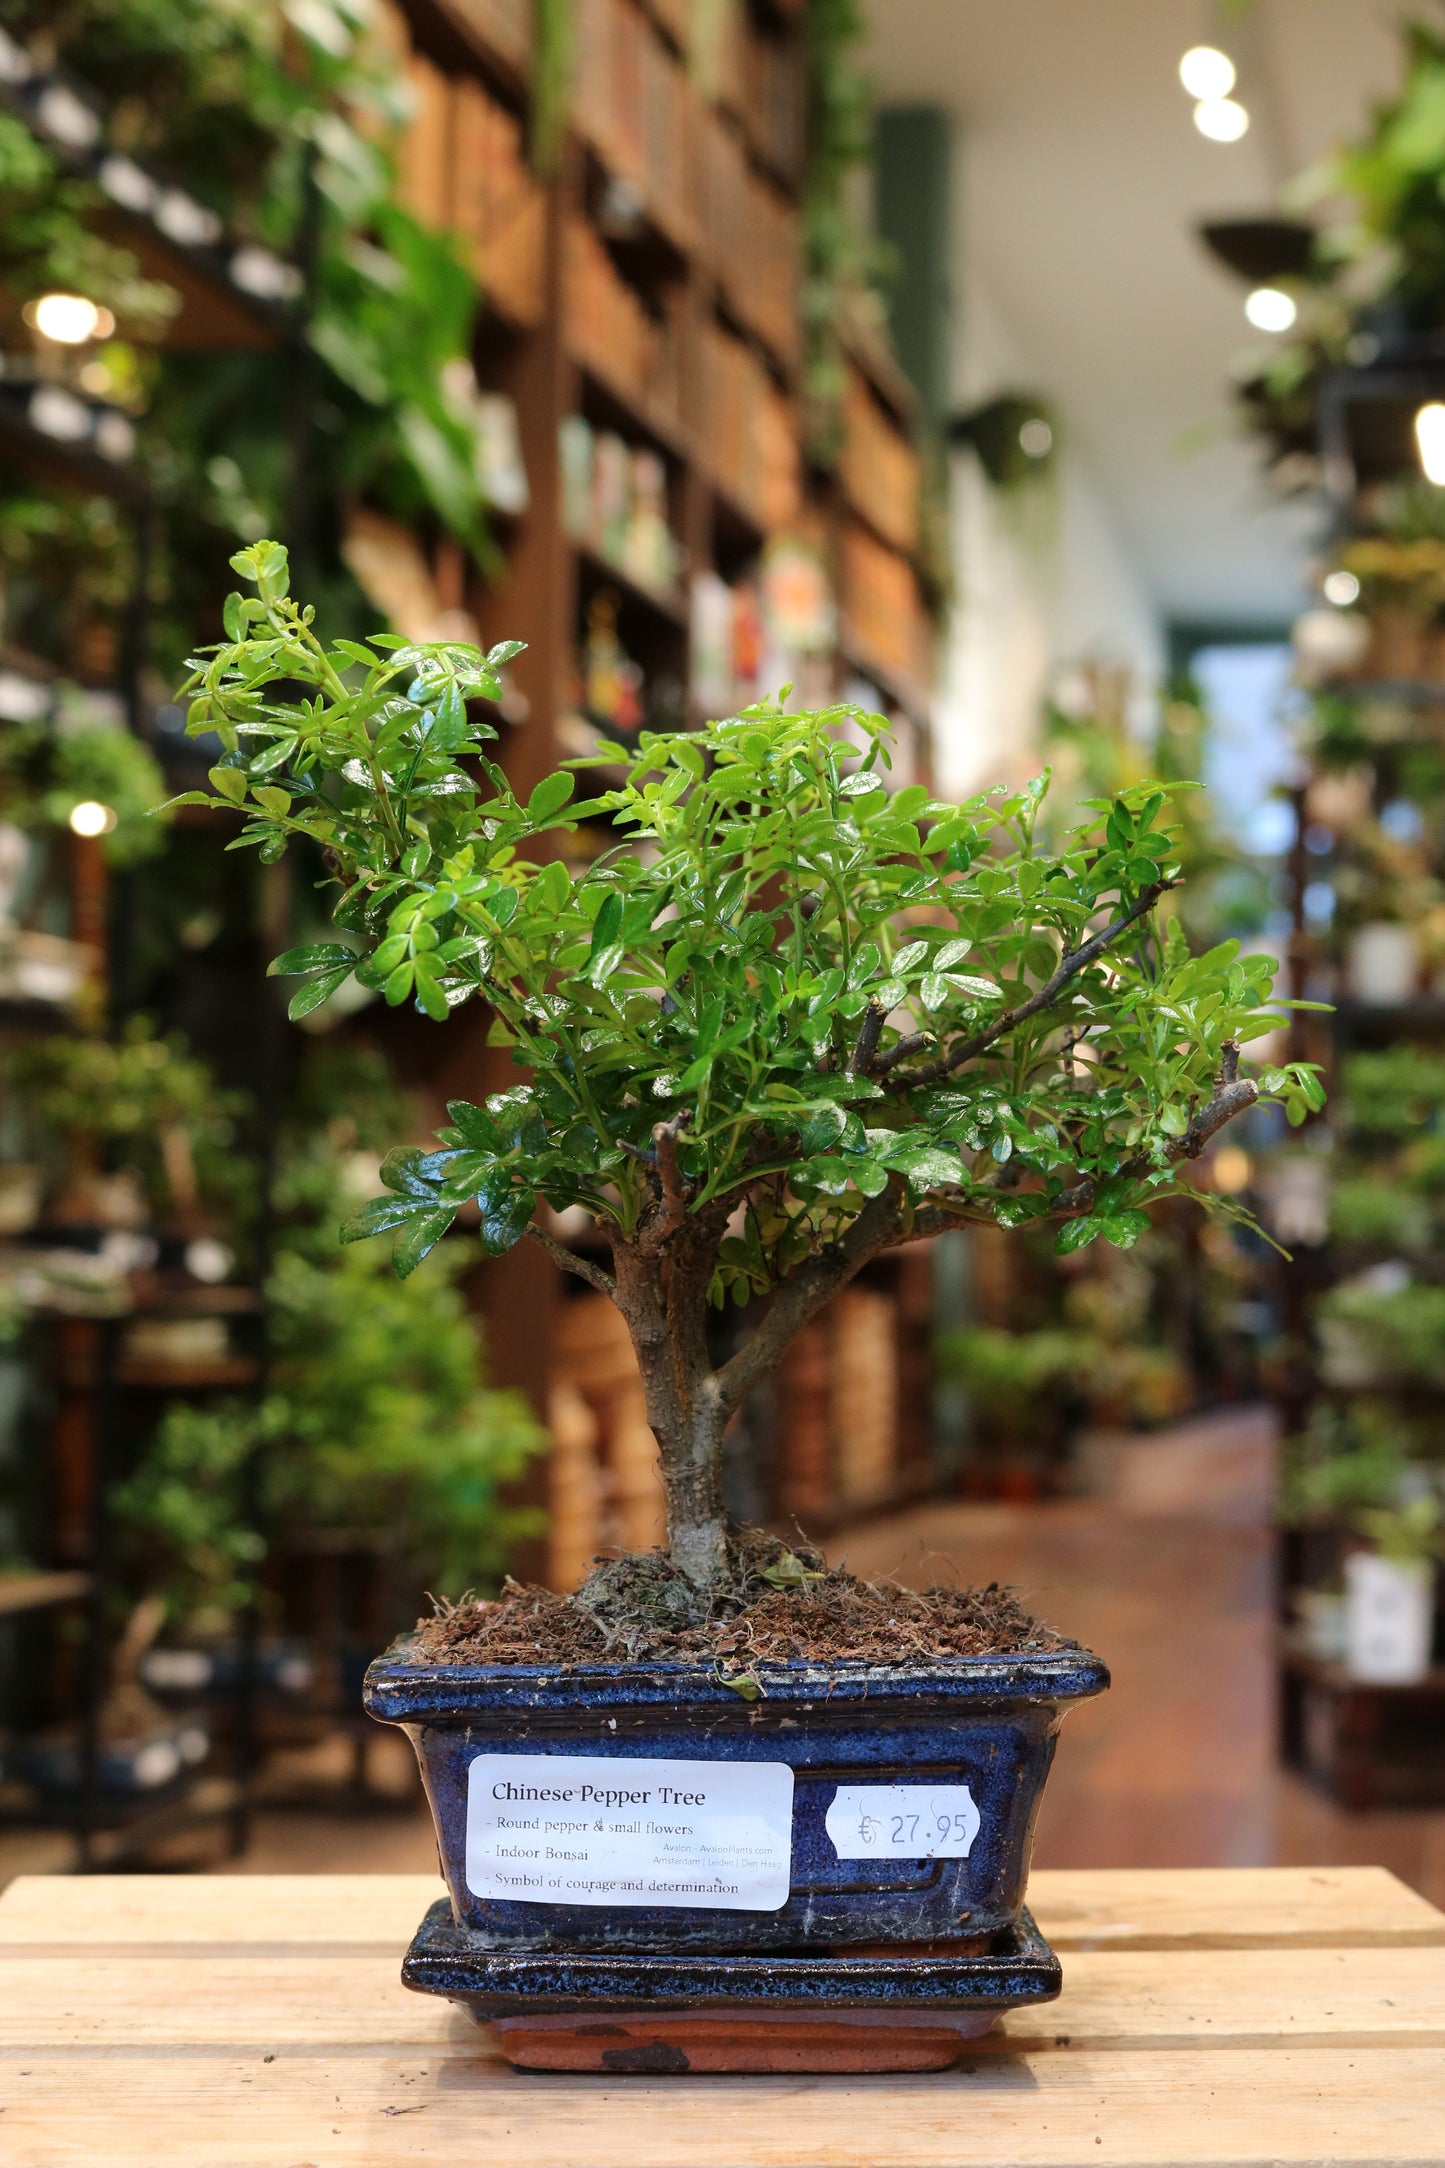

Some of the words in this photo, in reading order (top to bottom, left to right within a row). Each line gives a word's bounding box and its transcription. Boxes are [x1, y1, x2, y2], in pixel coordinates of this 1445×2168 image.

[492, 1782, 573, 1801] Chinese
[581, 1785, 651, 1808] Pepper
[658, 1787, 706, 1806] Tree
[497, 1816, 539, 1829] Round
[544, 1820, 588, 1834] pepper
[593, 1818, 604, 1832] &
[608, 1821, 641, 1834] small
[646, 1821, 694, 1835] flowers
[891, 1814, 967, 1843] 27.95
[496, 1845, 540, 1858] Indoor
[545, 1847, 588, 1861] Bonsai
[663, 1843, 691, 1853] Avalon
[653, 1856, 701, 1866] Amsterdam
[708, 1858, 733, 1867] Leiden
[741, 1858, 758, 1868] Den
[760, 1859, 782, 1870] Haag
[495, 1872, 543, 1887] Symbol
[548, 1875, 562, 1887] of
[566, 1881, 616, 1893] courage
[620, 1880, 643, 1891] and
[648, 1879, 739, 1893] determination
